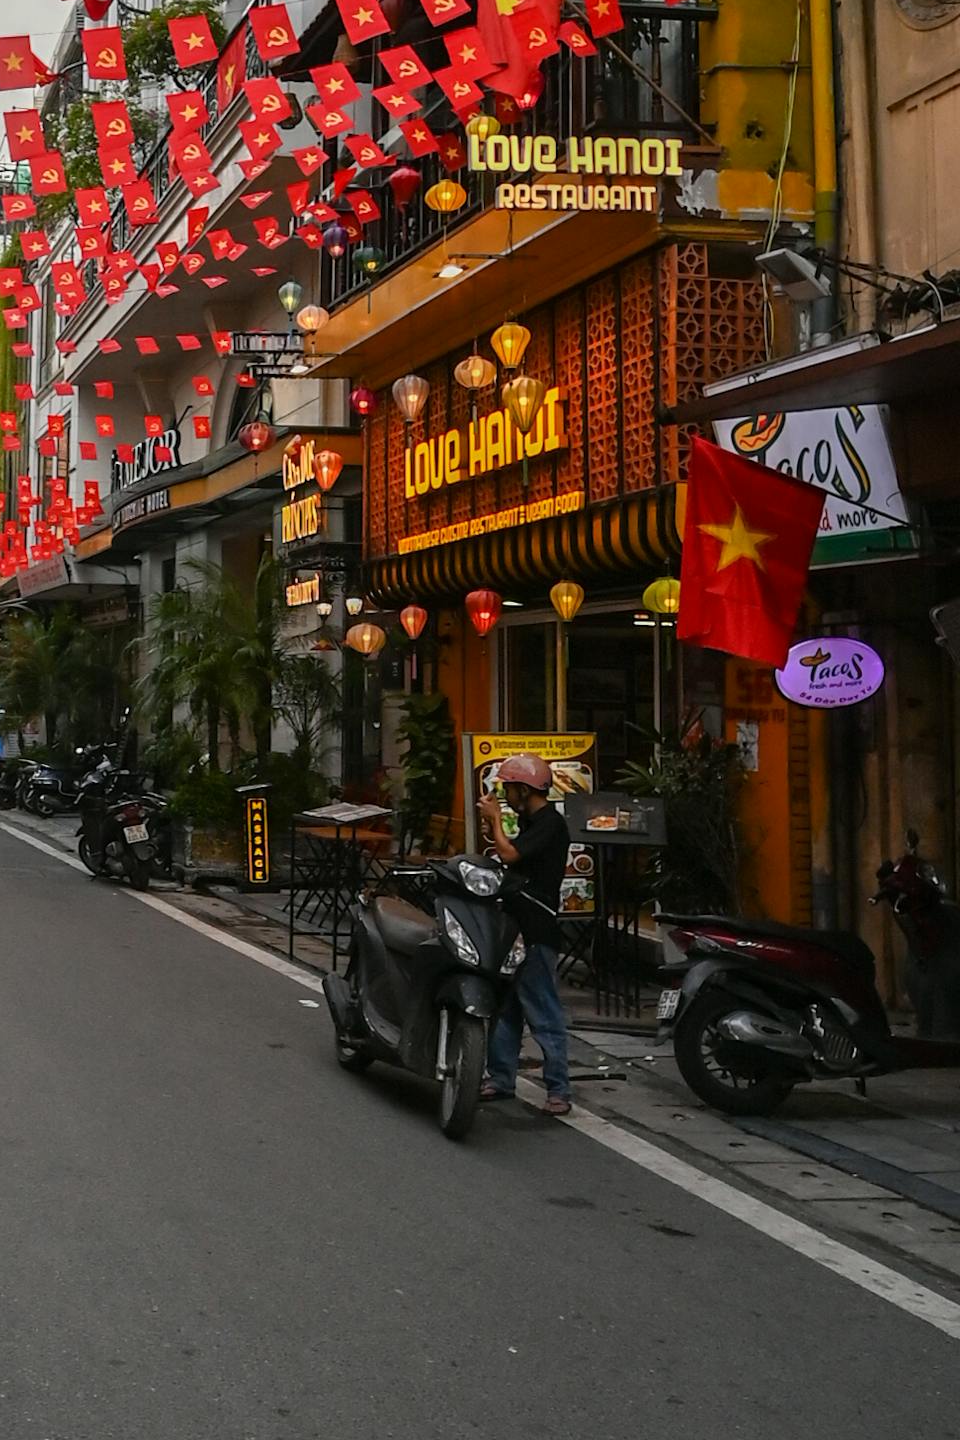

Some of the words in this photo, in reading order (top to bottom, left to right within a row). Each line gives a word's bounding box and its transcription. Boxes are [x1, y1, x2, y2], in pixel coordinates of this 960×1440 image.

[569, 135, 683, 176] HANOI
[496, 183, 657, 212] RESTAURANT
[405, 428, 461, 499] LOVE
[837, 508, 879, 530] more
[250, 800, 265, 880] MASSAGE
